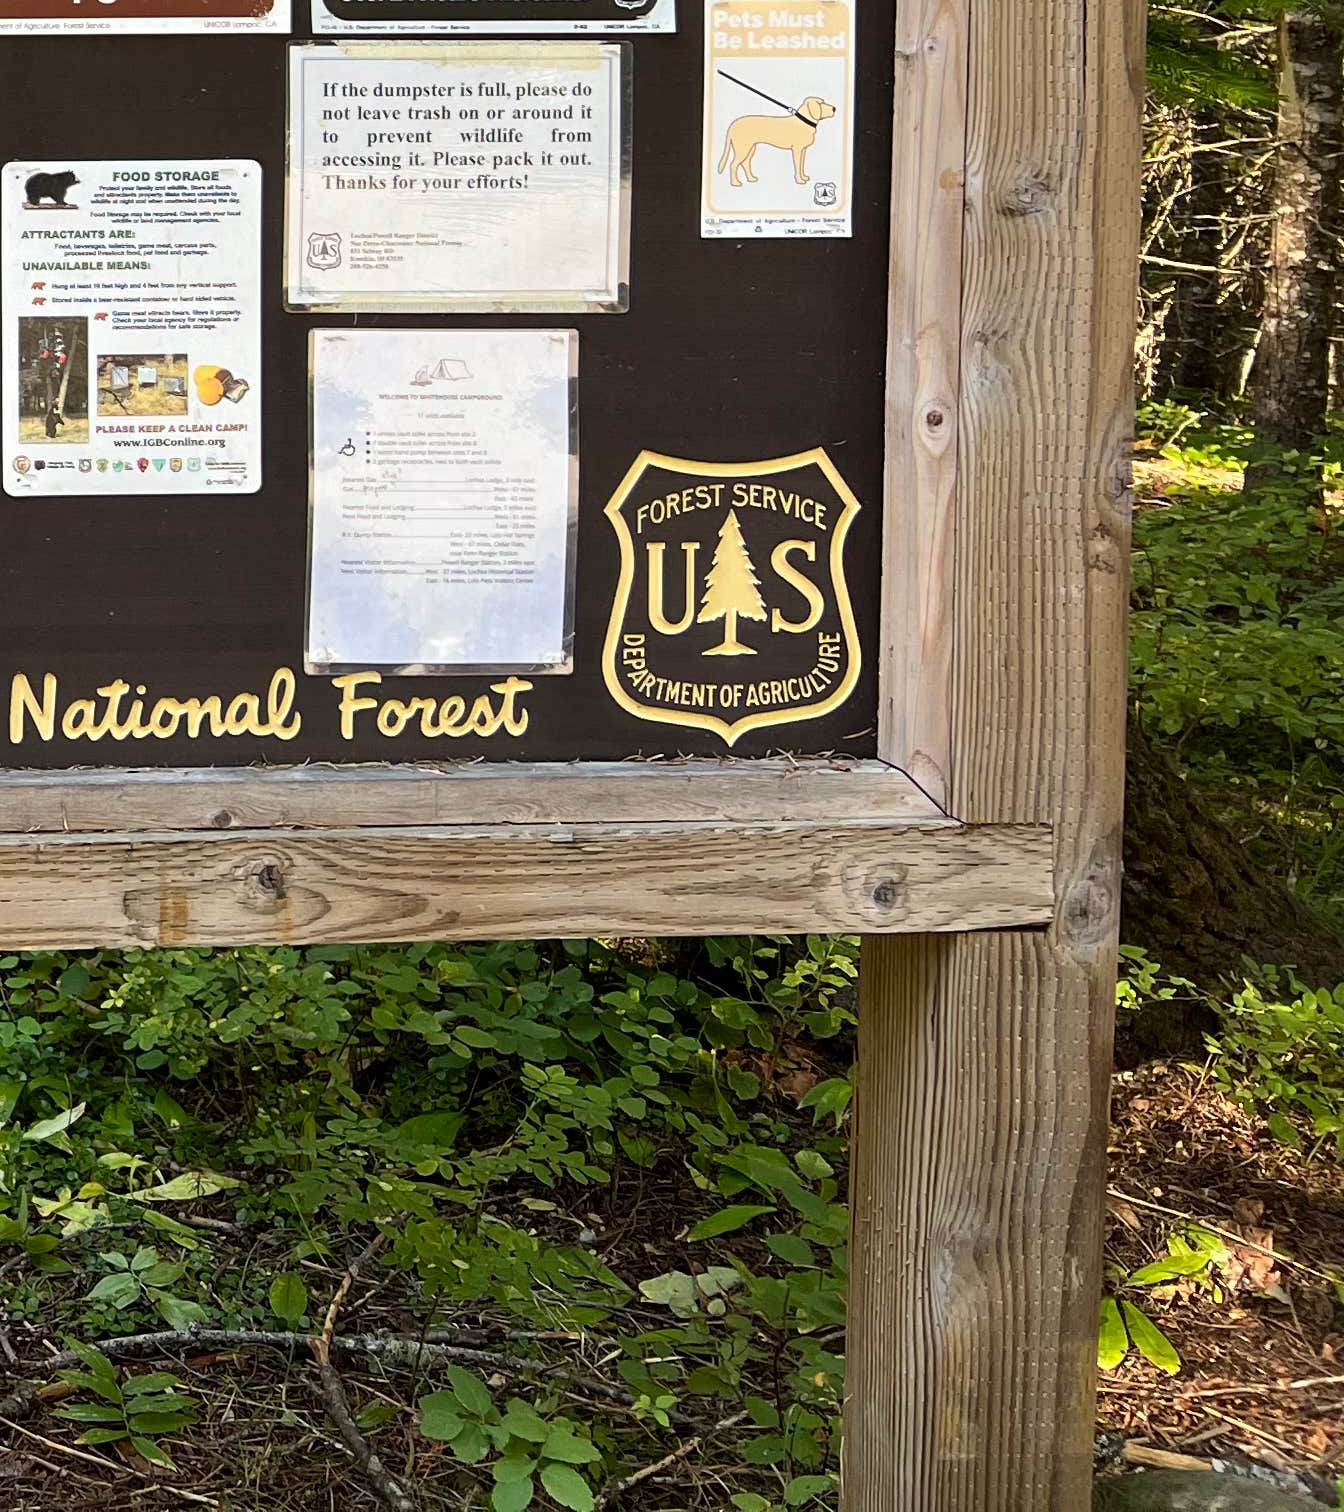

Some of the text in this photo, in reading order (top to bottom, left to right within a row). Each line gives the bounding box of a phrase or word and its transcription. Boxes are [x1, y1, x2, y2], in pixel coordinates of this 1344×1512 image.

[713, 9, 825, 29] Pets Must
[713, 31, 847, 50] Be Leashed
[323, 81, 592, 101] If the dumpster is full, please do
[112, 170, 220, 182] FOOD STORAGE
[322, 174, 529, 194] Thanks for your efforts!
[20, 229, 136, 240] ATTRACTANTS ARE:
[95, 423, 248, 434] PLEASE KEEP A CLEAN CAMP!
[113, 437, 226, 449] www.IGBConline.org
[636, 483, 828, 534] FOREST SERVICE
[623, 631, 841, 709] DEPARTMENT OF AGRICULTURE
[10, 668, 301, 743] National
[336, 671, 533, 738] Forest
